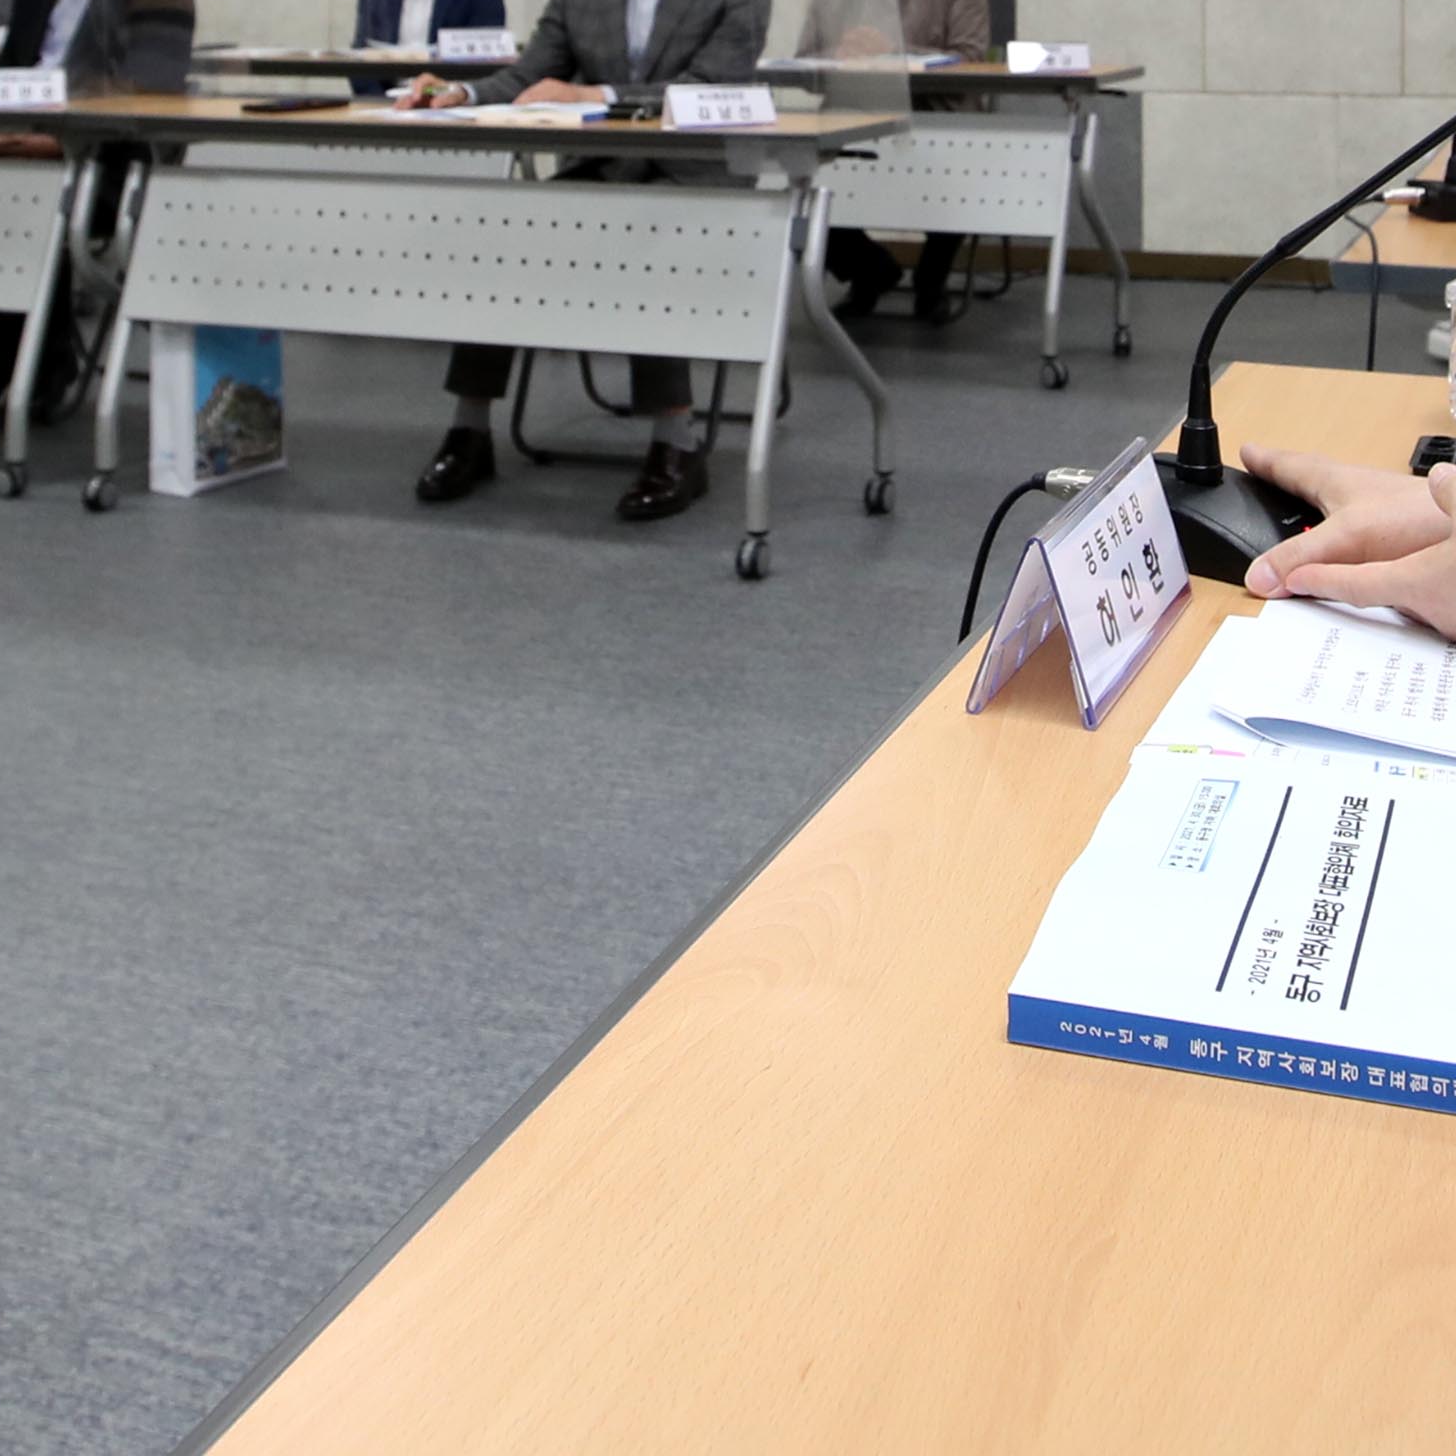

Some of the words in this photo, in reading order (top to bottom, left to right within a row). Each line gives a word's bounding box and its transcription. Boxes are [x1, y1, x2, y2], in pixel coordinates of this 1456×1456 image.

[1081, 492, 1144, 575] 공동위원장
[1333, 795, 1369, 840] 회의자료
[1318, 842, 1360, 897] 대표협의체
[1262, 927, 1284, 944] 4월
[1296, 899, 1345, 971] 지역사회보장
[1248, 947, 1278, 985] 2021년
[1285, 973, 1324, 1003] 동구
[1059, 1021, 1133, 1044] 2021년
[1139, 1034, 1169, 1051] 4월
[1190, 1038, 1228, 1062] 동구
[1236, 1046, 1359, 1082] 지역사회보장
